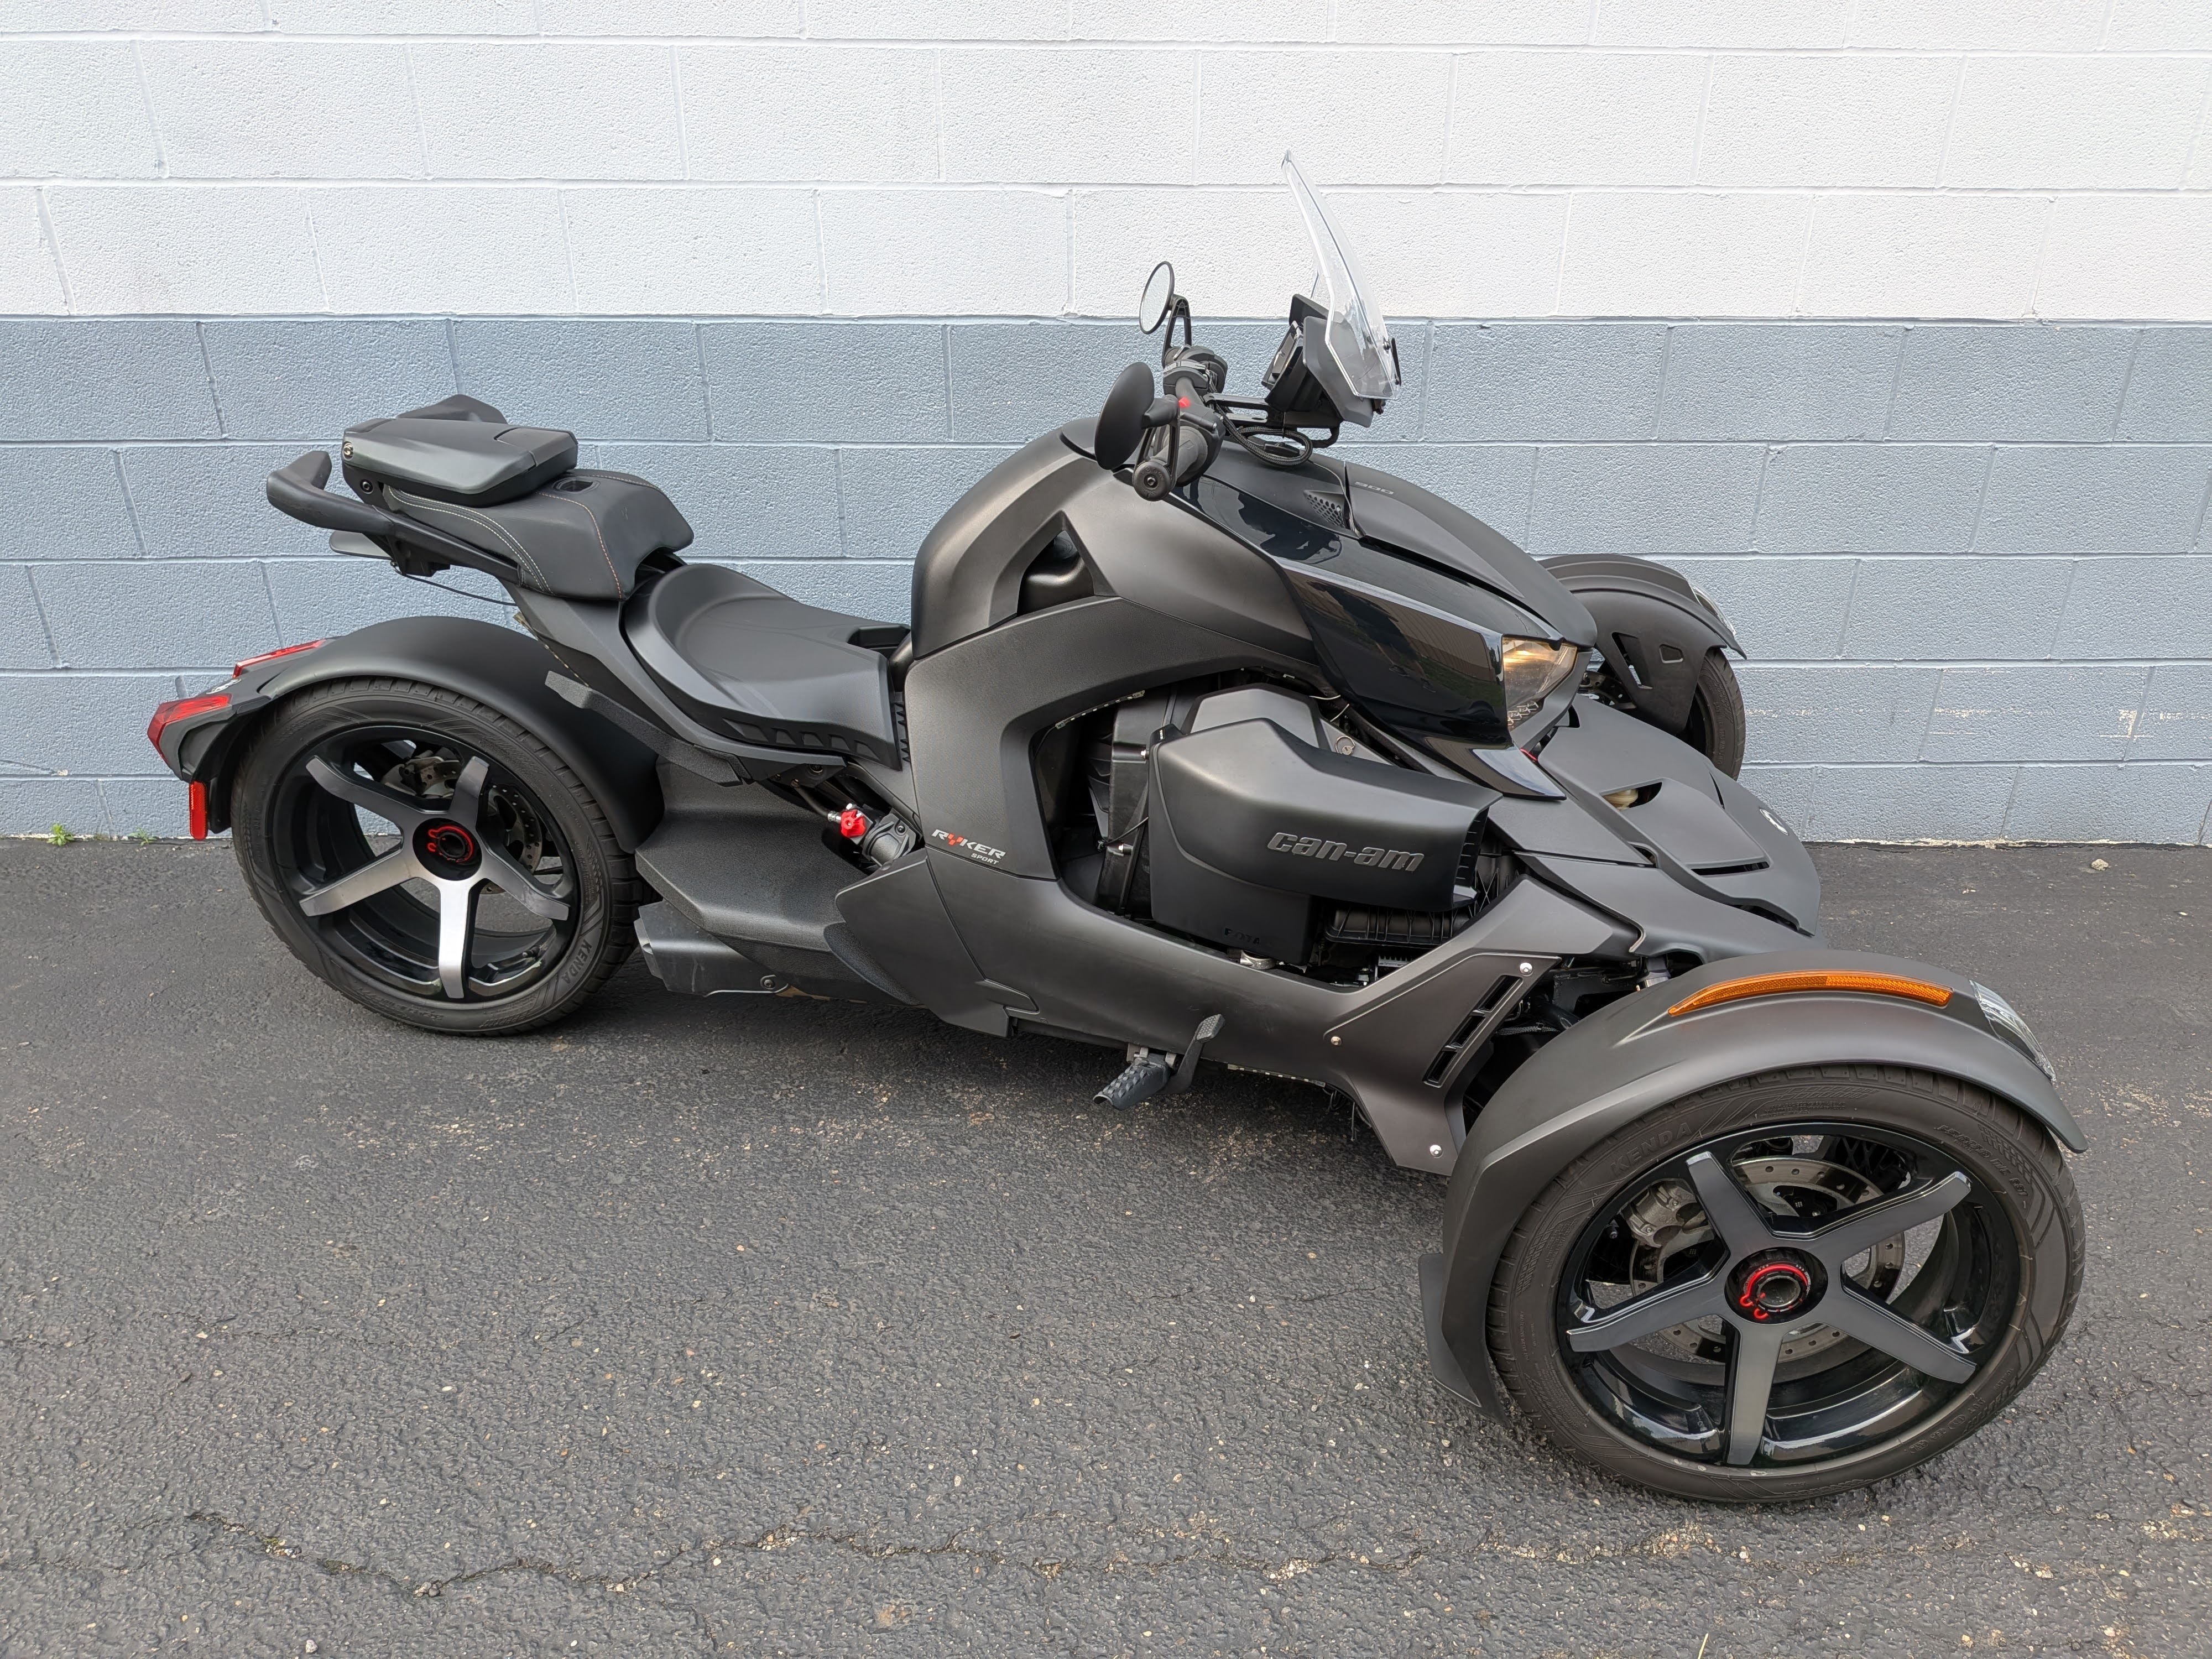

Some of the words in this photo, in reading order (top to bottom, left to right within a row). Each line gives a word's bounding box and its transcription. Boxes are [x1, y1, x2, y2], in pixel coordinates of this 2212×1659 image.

[1355, 481, 1394, 495] 900
[931, 829, 1006, 859] RYKER
[971, 853, 999, 865] SPORT
[1267, 832, 1425, 872] can-am
[1224, 927, 1272, 946] ROTA
[562, 939, 592, 984] KENDA
[1610, 1122, 1692, 1177] KENDA
